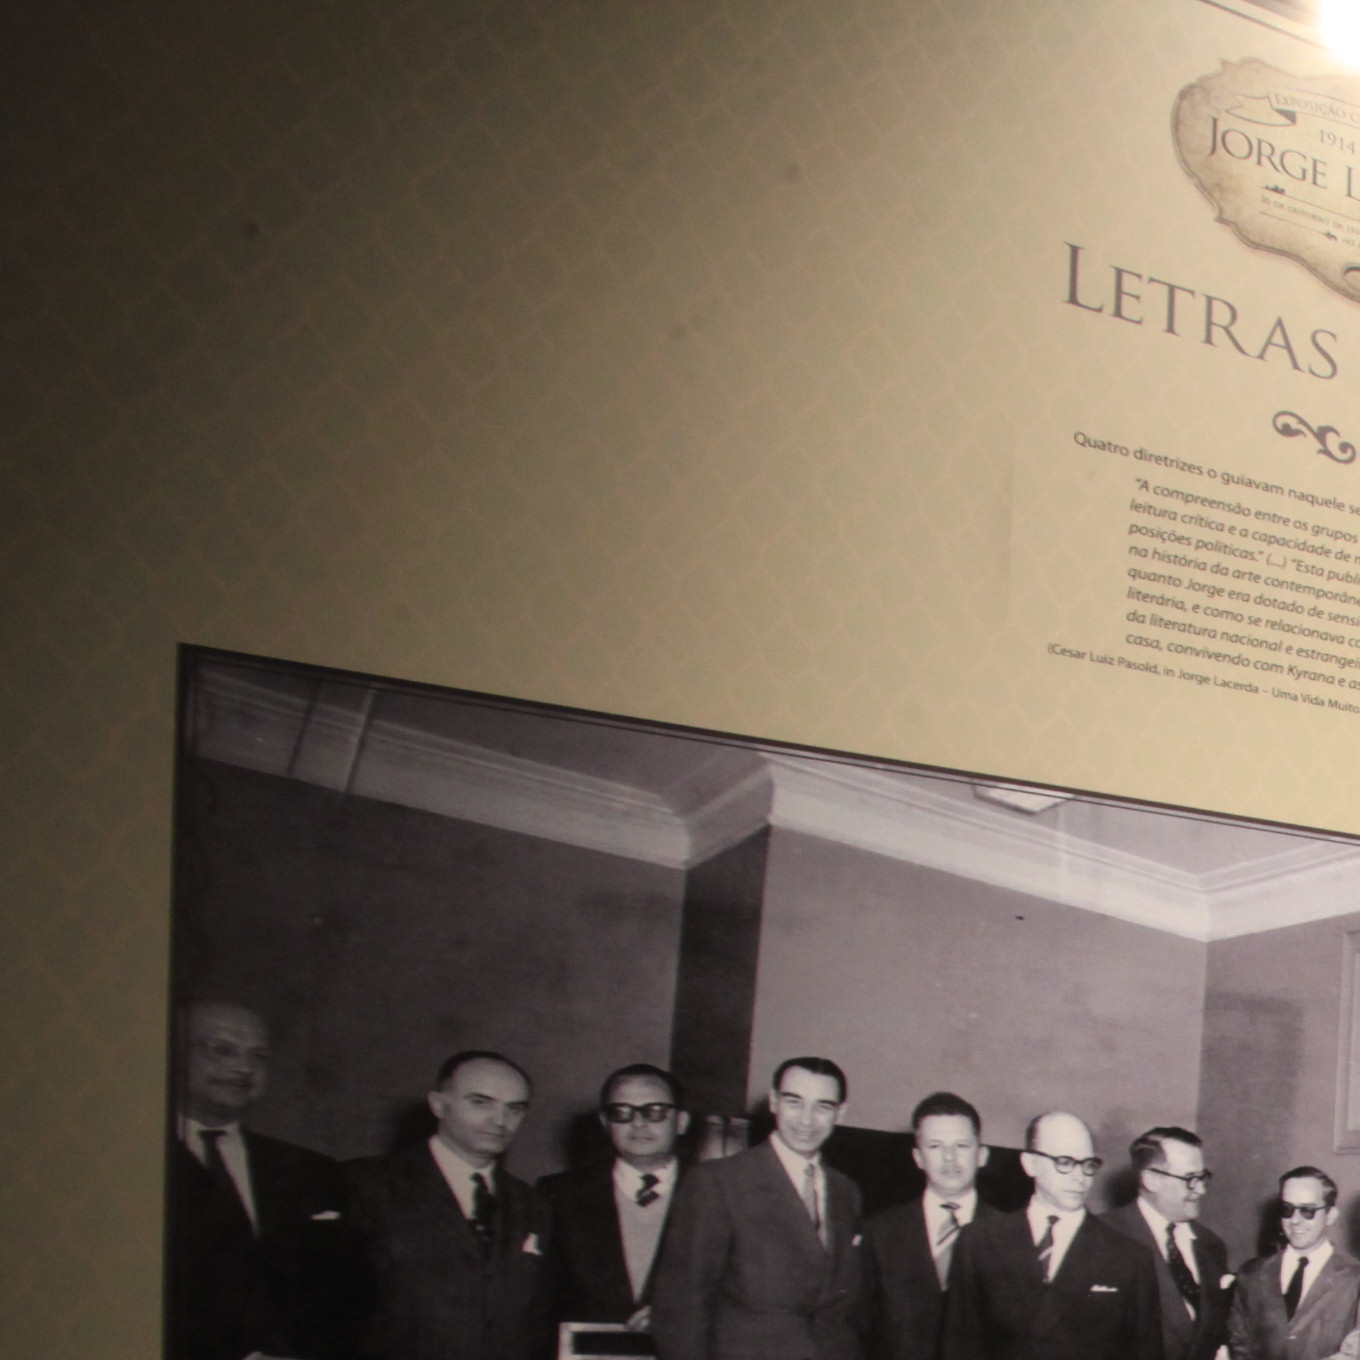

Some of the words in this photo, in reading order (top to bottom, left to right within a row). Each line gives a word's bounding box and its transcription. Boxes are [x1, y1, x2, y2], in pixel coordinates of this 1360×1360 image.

[1208, 116, 1328, 189] JORGE
[1318, 129, 1355, 155] 1914
[1063, 242, 1339, 380] LETRAS
[1073, 430, 1129, 457] Quatro
[1133, 447, 1203, 476] diretrizes
[1221, 471, 1284, 495] guiavam
[1288, 487, 1345, 512] naquele
[1129, 497, 1178, 521] leitura
[1180, 513, 1225, 532] crítica
[1251, 530, 1332, 559] capacidade
[1334, 548, 1350, 563] de
[1152, 484, 1250, 517] compreensão
[1254, 509, 1290, 527] entre
[1293, 518, 1308, 531] os
[1311, 523, 1358, 544] grupos
[1128, 544, 1148, 558] na
[1151, 546, 1207, 572] história
[1210, 560, 1229, 577] da
[1231, 568, 1261, 584] arte
[1127, 566, 1182, 588] quanto
[1184, 577, 1224, 598] Jorge
[1227, 589, 1250, 603] era
[1253, 592, 1304, 615] dotado
[1307, 604, 1324, 620] de
[1202, 605, 1244, 623] como
[1246, 614, 1262, 627] se
[1264, 617, 1344, 645] relacionava
[1166, 641, 1250, 667] convivendo
[1252, 659, 1284, 674] com
